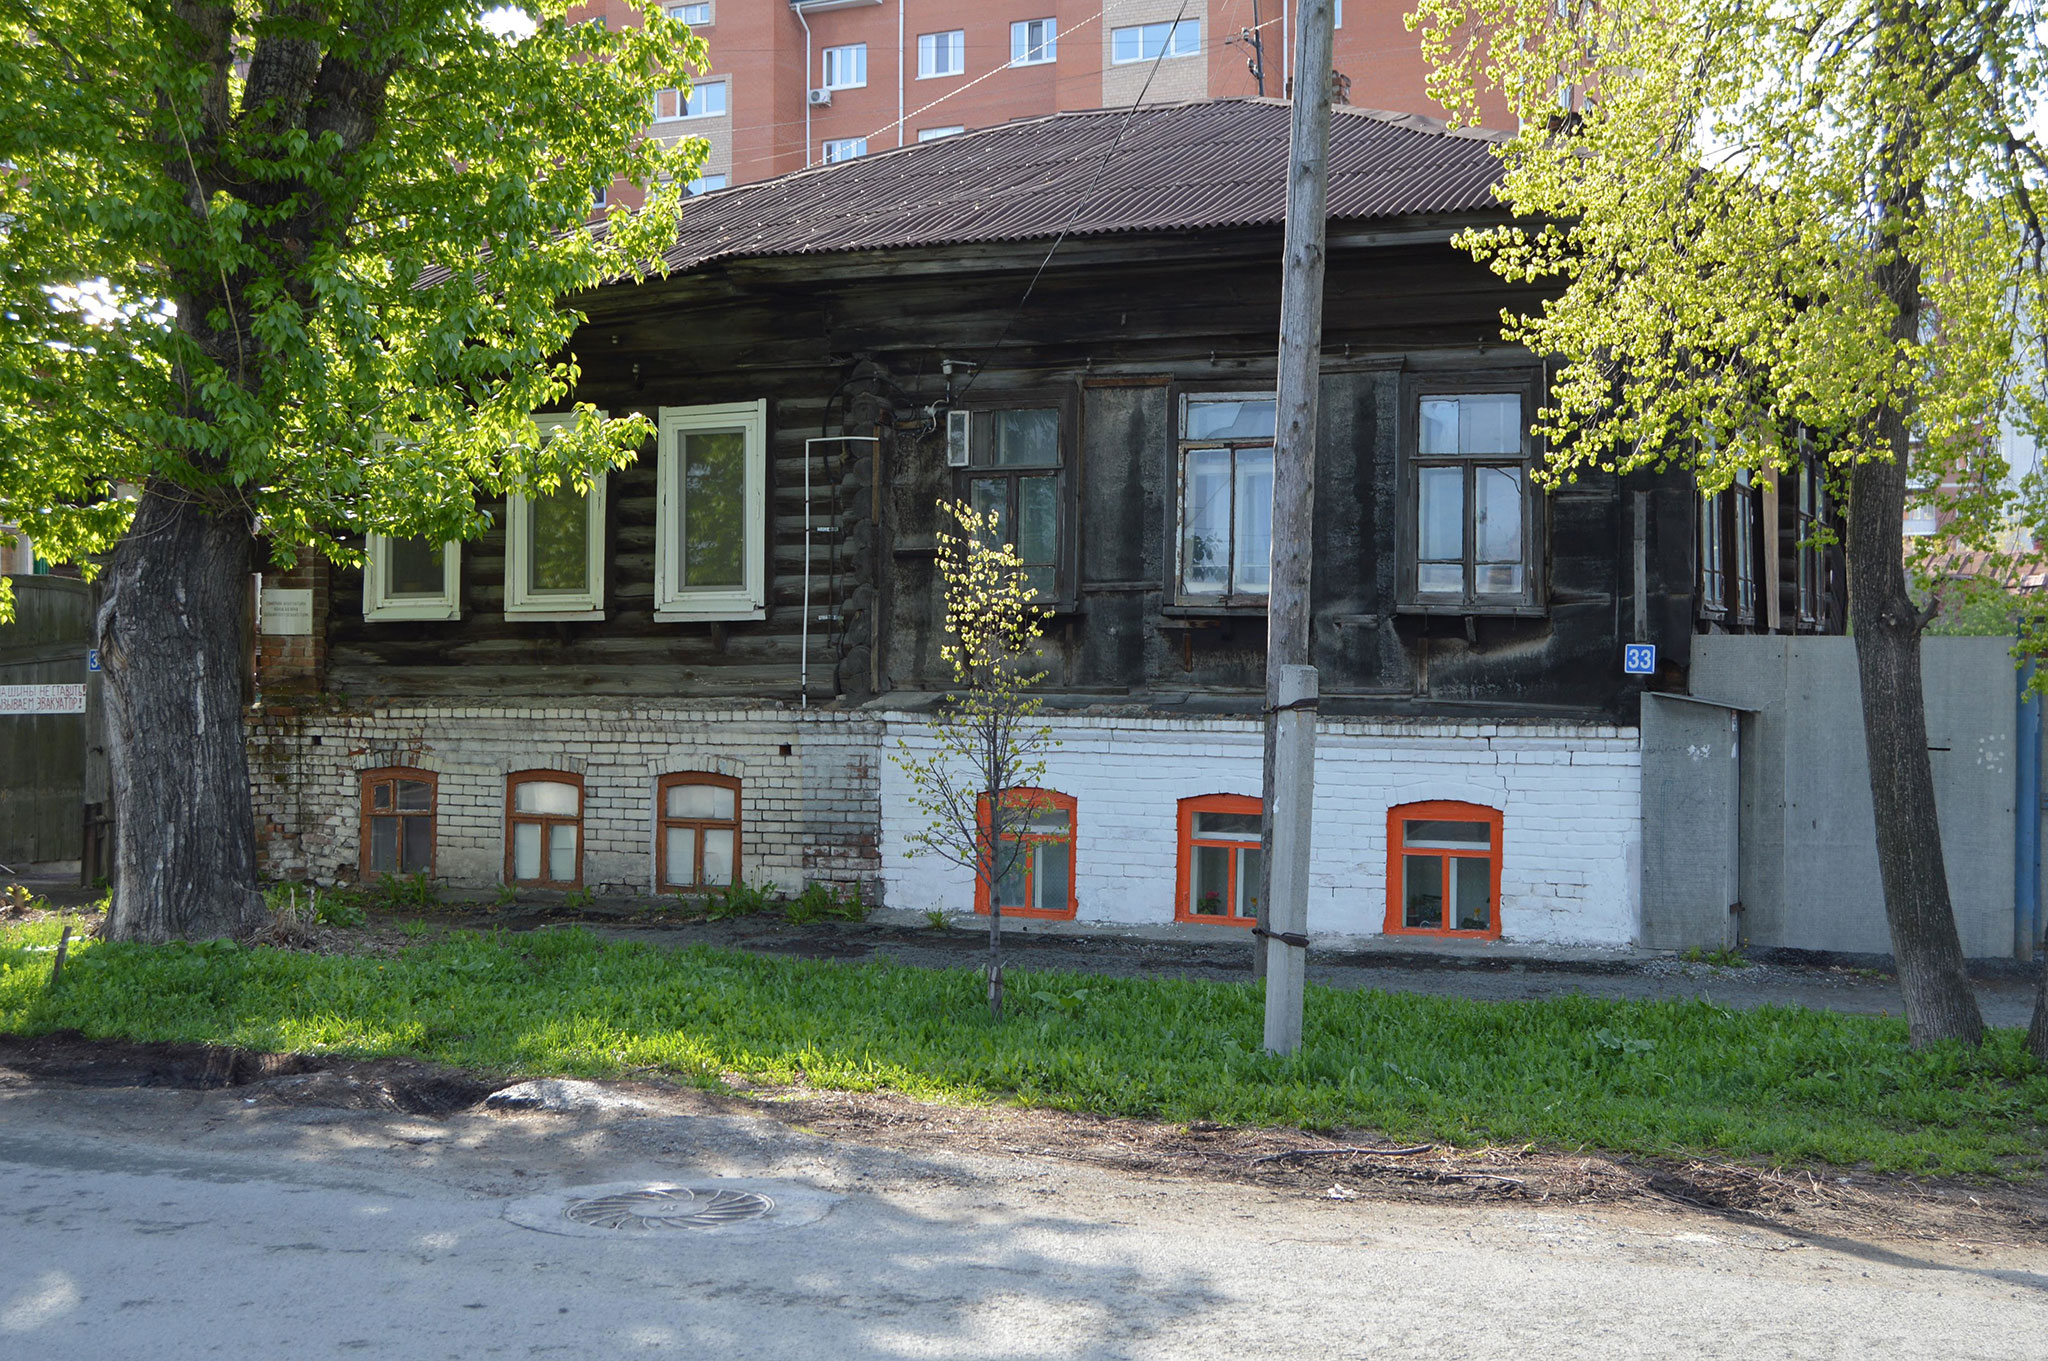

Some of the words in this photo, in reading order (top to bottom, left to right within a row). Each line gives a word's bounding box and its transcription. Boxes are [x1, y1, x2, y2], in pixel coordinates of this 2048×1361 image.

[1628, 649, 1651, 669] 33
[0, 686, 37, 697] АШИНЫ
[40, 686, 50, 697] НЕ
[52, 685, 86, 697] СТАВИТЬ!
[36, 697, 82, 710] ЭВАКУАТОР!
